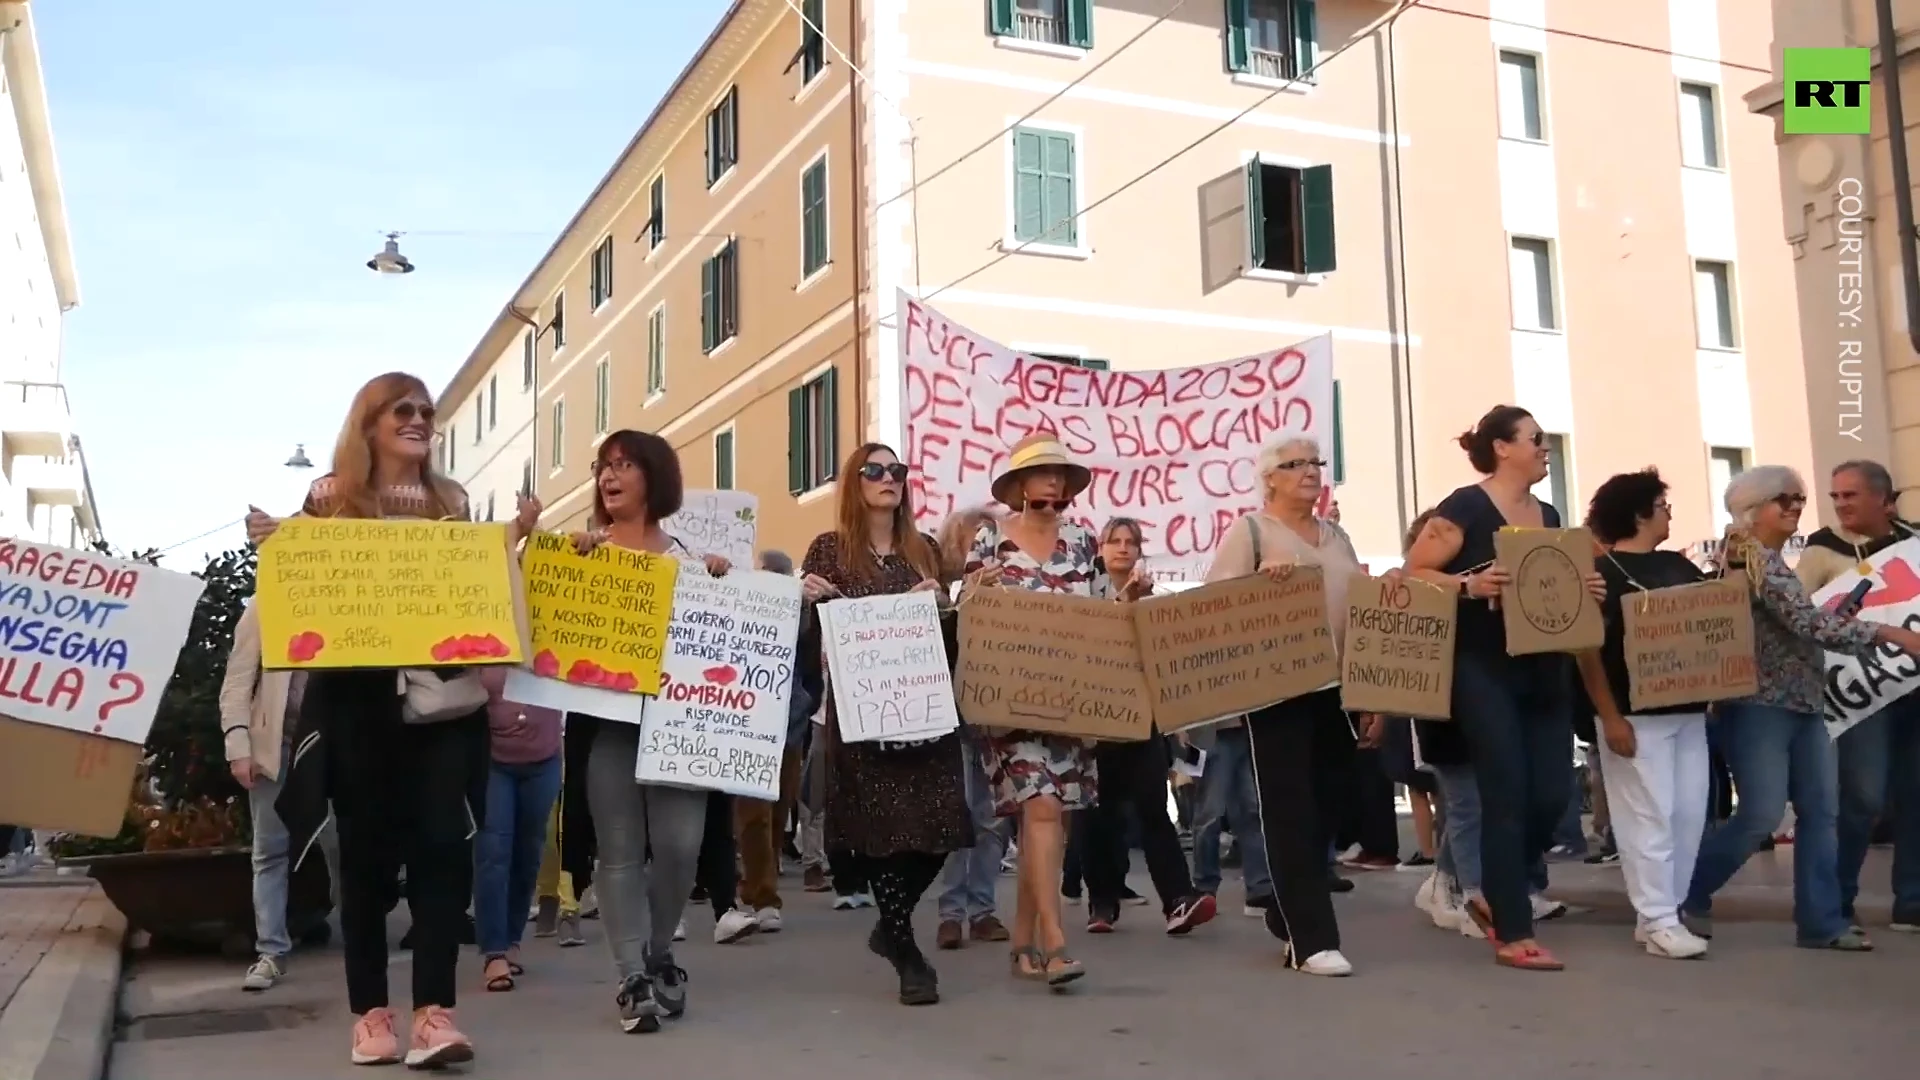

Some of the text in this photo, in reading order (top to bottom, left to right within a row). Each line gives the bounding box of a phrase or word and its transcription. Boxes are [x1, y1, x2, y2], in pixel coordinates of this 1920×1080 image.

[1001, 357, 1168, 410] AGENDA
[1172, 348, 1307, 403] 2030
[905, 365, 994, 436] DEL
[995, 396, 1097, 455] GAS
[332, 525, 398, 542] GUERRA
[404, 526, 434, 542] NON
[0, 537, 139, 599] RAGEDIA
[275, 546, 490, 566] BUTTATA FUORI DALLA STORIA
[535, 534, 566, 553] NON
[618, 550, 659, 573] FARE
[276, 566, 317, 584] DEGLI
[434, 566, 454, 580] LA
[531, 562, 550, 577] LA
[552, 564, 586, 584] NAVE
[589, 573, 656, 598] GASIERA
[287, 583, 490, 601] GUERRA A BUTTARE FUORI
[529, 579, 561, 599] NON
[563, 585, 577, 601] CI
[614, 594, 661, 616] STARE
[1378, 581, 1412, 610] NO
[291, 602, 317, 618] GLI
[328, 602, 384, 617] UOMINI
[396, 602, 448, 617] DALLA
[532, 604, 658, 640] IL NOSTRO PORTO
[1149, 606, 1183, 625] UNA
[1349, 604, 1450, 640] RIGASSIFICATORI
[550, 626, 608, 651] TROPPO
[681, 608, 736, 632] GOVERNO
[740, 620, 779, 642] INVIA
[1172, 627, 1217, 646] PAURA
[331, 635, 392, 650] STRADA
[667, 625, 792, 662] ARMI E LA SICUREZZA
[674, 642, 748, 666] DIPENDE DA
[1183, 642, 1255, 671] COMMERCIO
[845, 648, 881, 674] STOP
[902, 644, 942, 668] ARMI
[652, 671, 757, 711] PIOMBINO
[740, 663, 792, 700] NOI?
[893, 690, 907, 700] DI
[685, 707, 751, 728] RISPONDE
[856, 692, 946, 734] PACE
[1079, 699, 1142, 724] GRAZIE
[729, 746, 779, 772] RIPUDIA
[658, 757, 775, 791] LA GUERRA
